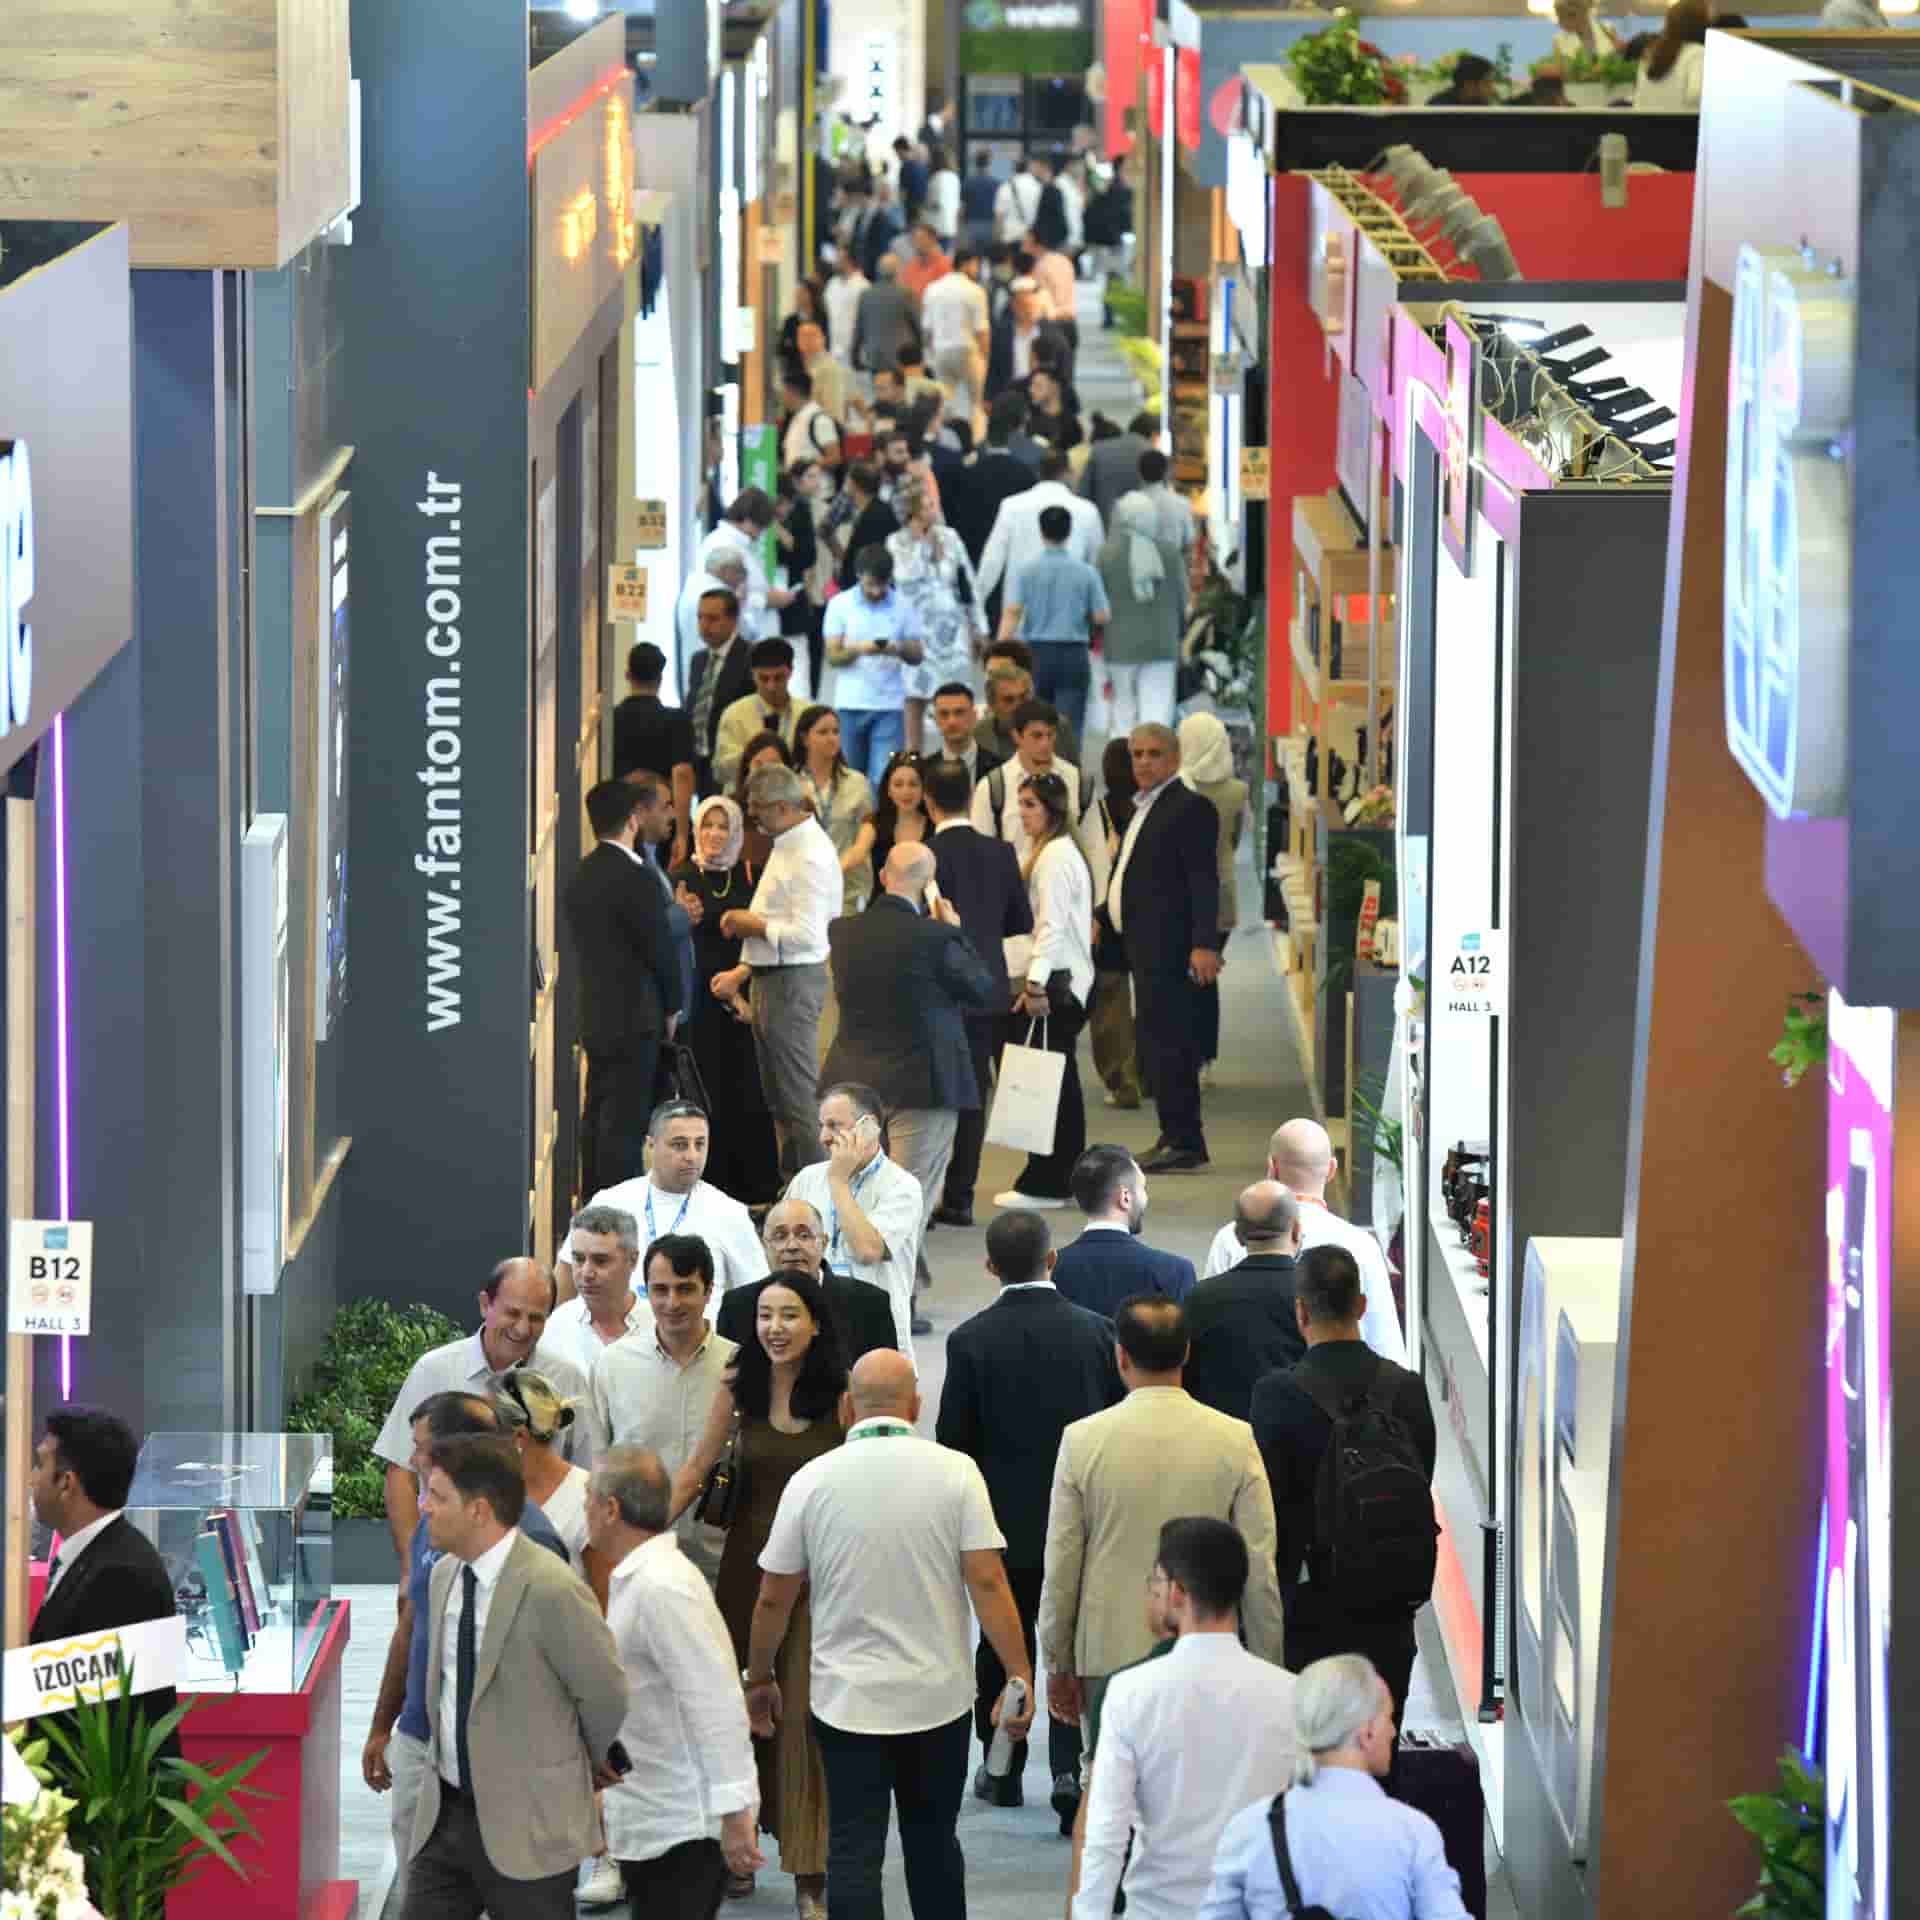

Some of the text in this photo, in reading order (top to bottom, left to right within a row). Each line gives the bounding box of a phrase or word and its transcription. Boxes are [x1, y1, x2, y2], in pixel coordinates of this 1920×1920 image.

[414, 471, 463, 1033] www.fantom.com.tr
[1450, 955, 1490, 974] A12
[1448, 1001, 1479, 1012] HALL
[29, 1256, 81, 1281] B12
[24, 1317, 81, 1331] HALL 3
